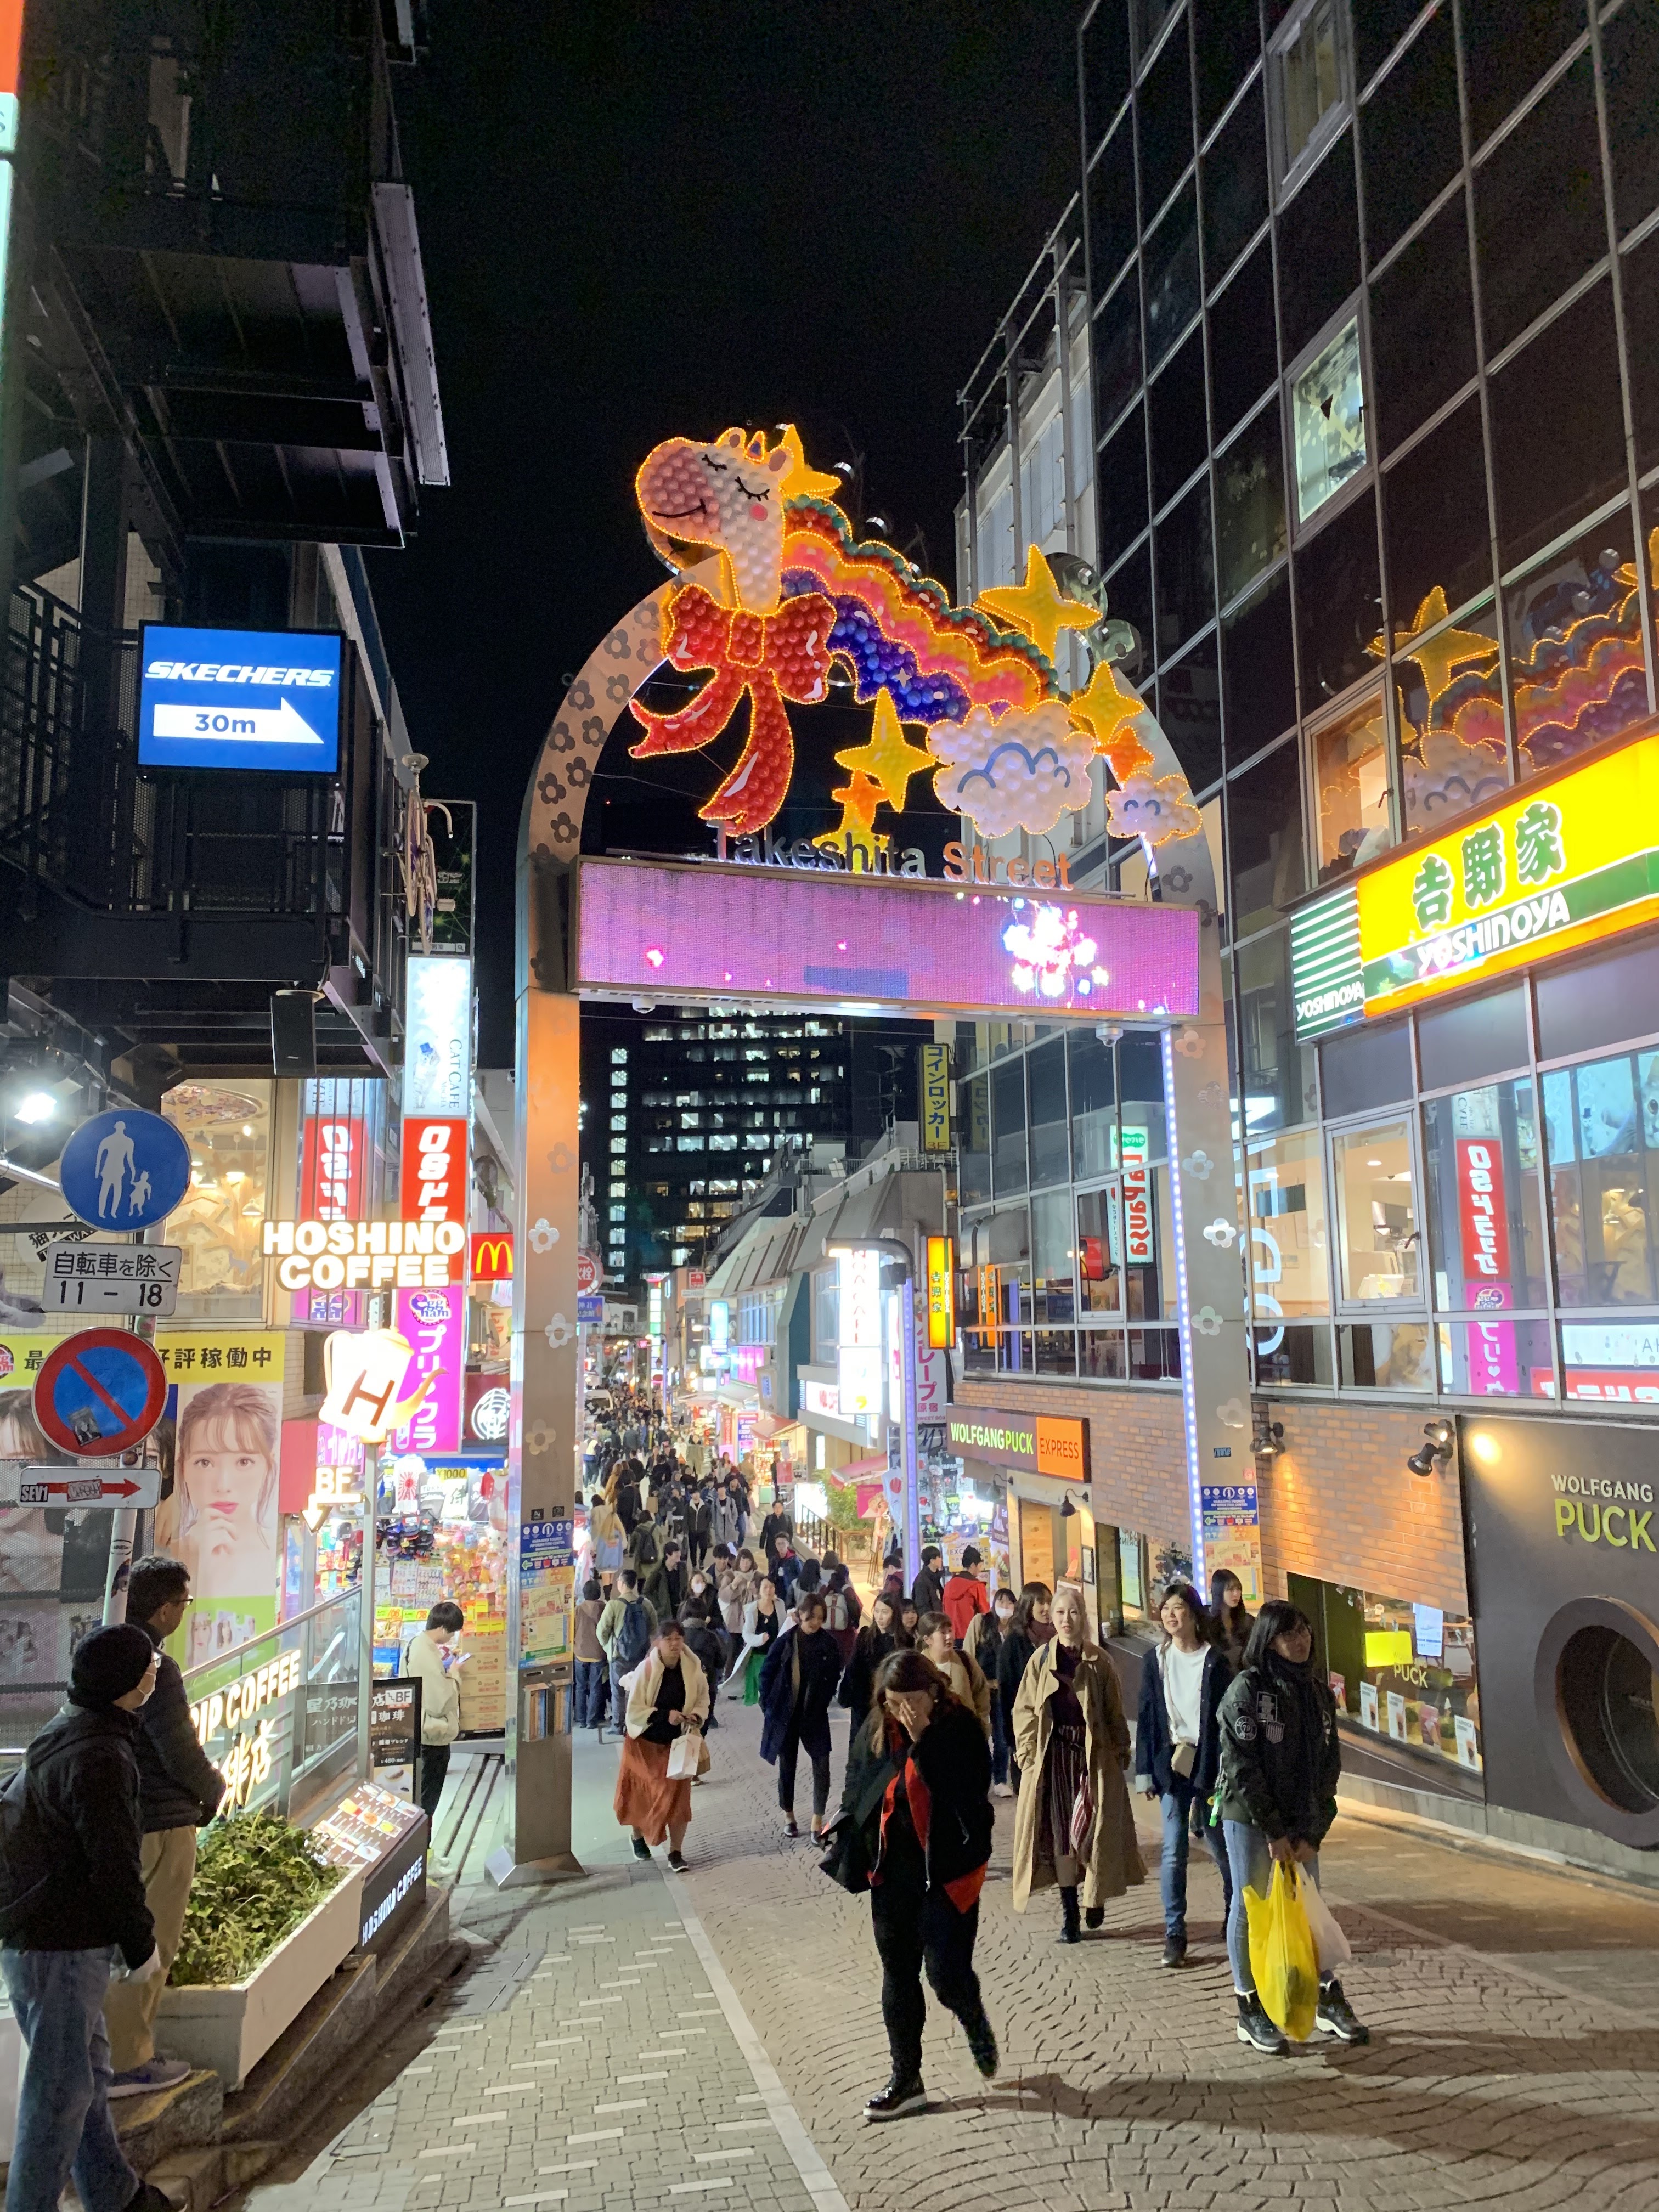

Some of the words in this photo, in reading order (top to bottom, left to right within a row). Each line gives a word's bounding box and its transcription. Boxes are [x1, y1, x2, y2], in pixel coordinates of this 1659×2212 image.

[145, 661, 334, 687] SKECHERS
[195, 714, 256, 734] 30m
[707, 820, 926, 878] Takeshita
[943, 841, 1074, 890] Street
[1413, 801, 1566, 930] 吉野家
[1418, 891, 1570, 974] YOSHINOYA
[1297, 981, 1364, 1020] YOSHINOYA
[450, 1039, 462, 1066] CAT
[449, 1072, 462, 1108] CAFE
[926, 1047, 946, 1138] コインロッカー
[263, 1221, 465, 1255] HOSHINO
[55, 1251, 173, 1277] 自転車を除く
[280, 1255, 449, 1289] COFFEE
[60, 1280, 83, 1304] 11
[139, 1283, 162, 1307] 18
[932, 1271, 941, 1312] 吉野家
[342, 1369, 395, 1426] H
[917, 1403, 938, 1412] 原宿
[950, 1422, 1005, 1449] WOLFGANG
[1005, 1430, 1034, 1454] PUCK
[1040, 1438, 1079, 1459] EXPRESS
[1551, 1474, 1654, 1503] WOLFGANG
[1555, 1499, 1657, 1553] PUCK
[226, 1650, 300, 1728] COFFEE
[1394, 1663, 1428, 1689] PUCK
[396, 1691, 410, 1702] BF
[397, 1855, 422, 1901] COFFEE
[362, 1888, 396, 1946] HOSHINO
